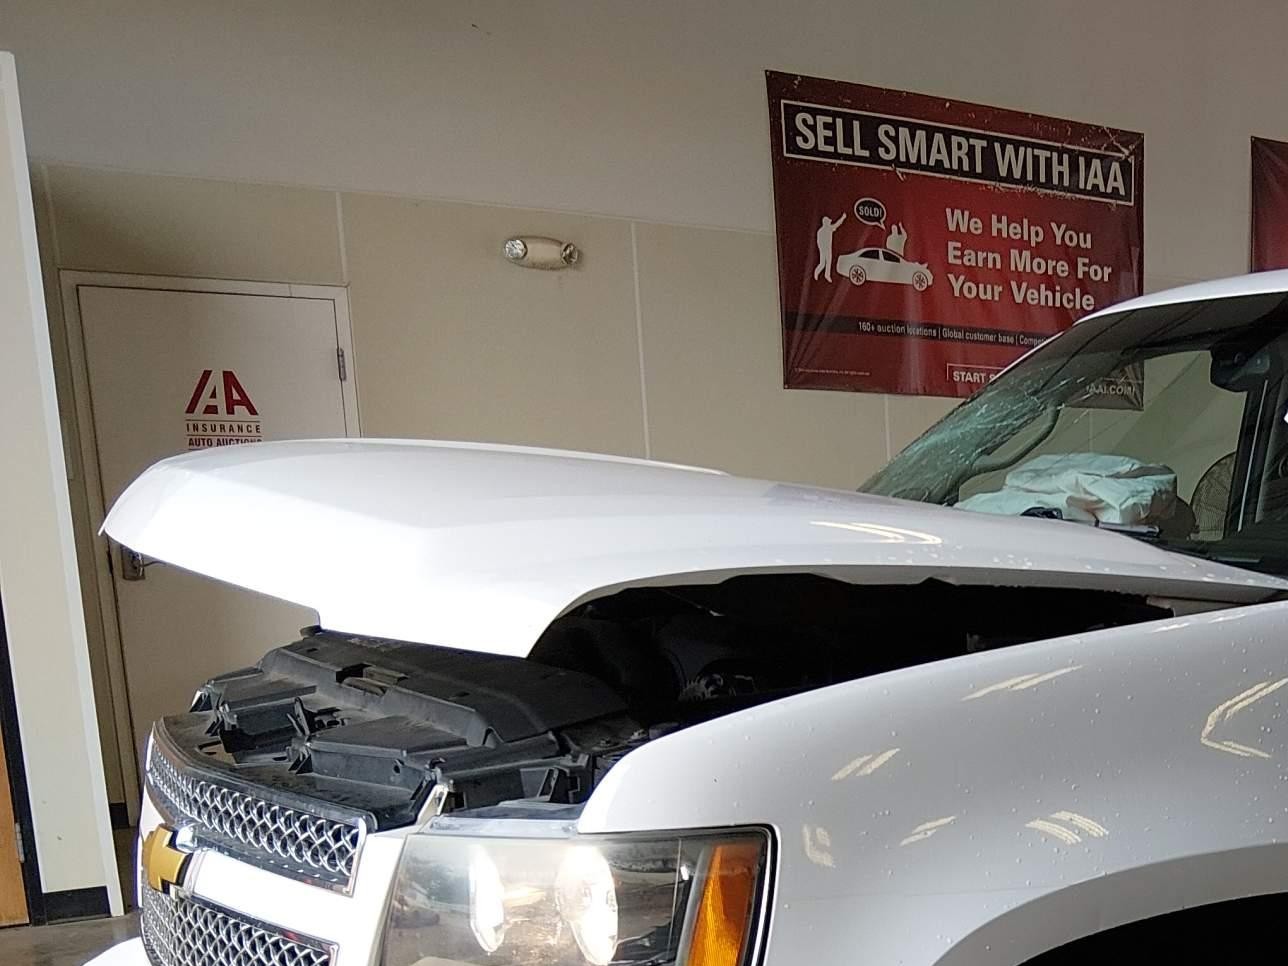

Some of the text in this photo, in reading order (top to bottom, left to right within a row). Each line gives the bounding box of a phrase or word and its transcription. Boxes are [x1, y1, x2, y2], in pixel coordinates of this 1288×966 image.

[795, 112, 1126, 196] SELL SMART WITH IAA
[858, 206, 882, 218] SOLD!
[945, 207, 1092, 249] We Help You
[947, 241, 1113, 282] Earn More For
[947, 273, 1095, 311] Your Vehicle
[858, 321, 875, 332] 160+
[876, 323, 906, 334] auction
[906, 324, 937, 337] locations
[942, 327, 965, 340] Global
[965, 331, 997, 342] customer
[998, 333, 1014, 344] base
[952, 370, 987, 384] START
[186, 423, 261, 434] INSURANCE
[188, 437, 213, 447] AUTO
